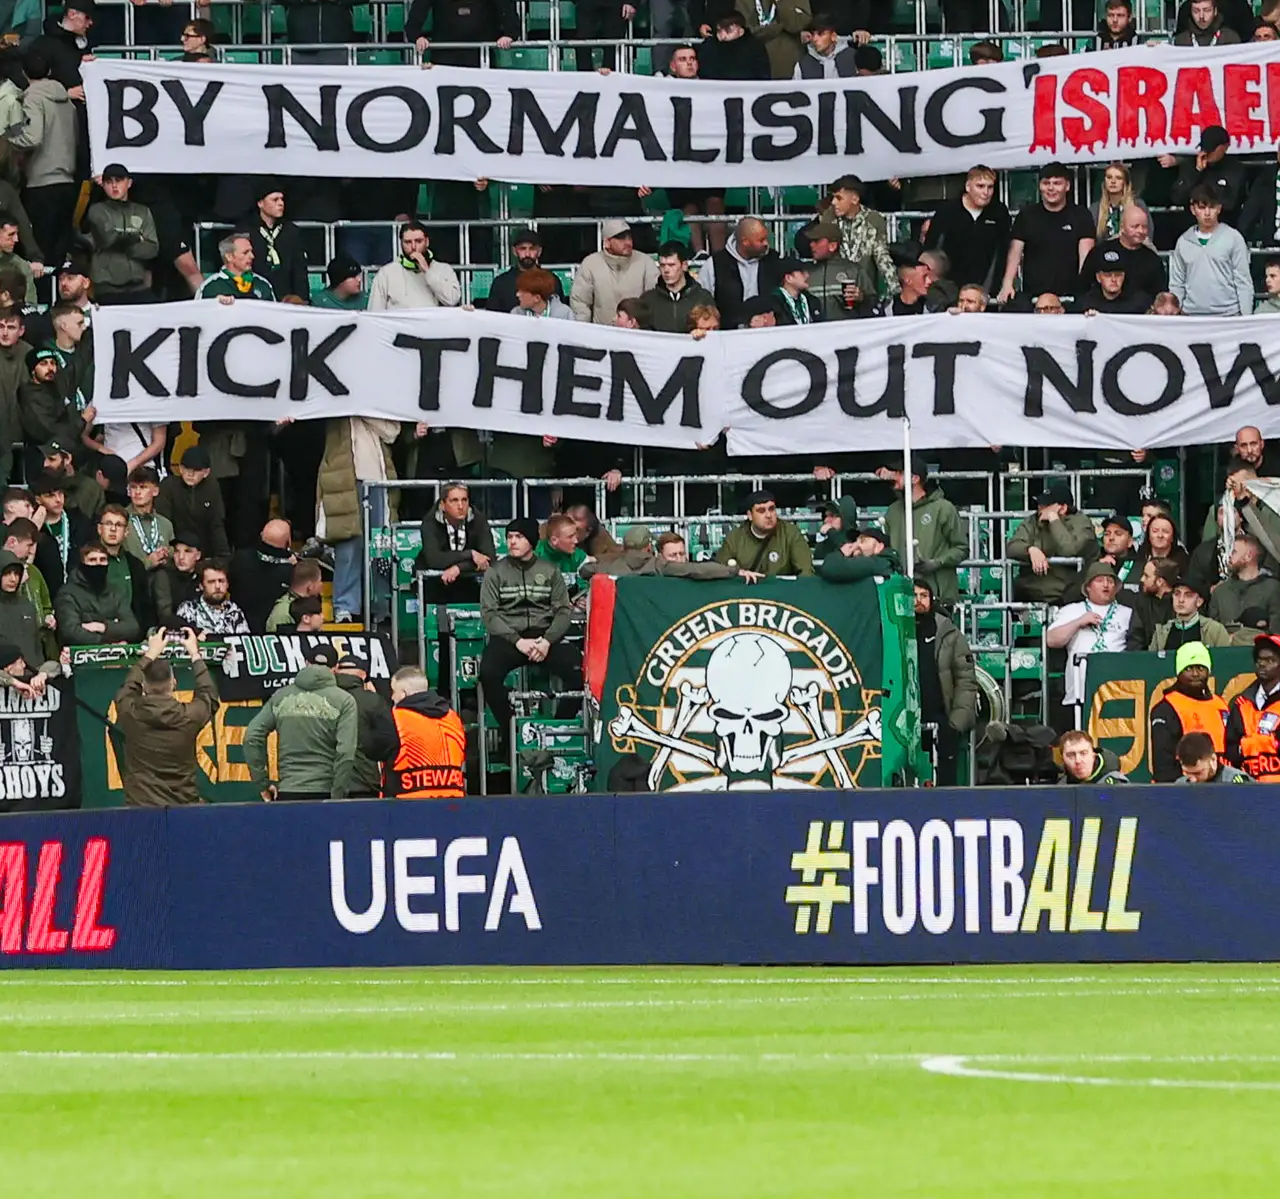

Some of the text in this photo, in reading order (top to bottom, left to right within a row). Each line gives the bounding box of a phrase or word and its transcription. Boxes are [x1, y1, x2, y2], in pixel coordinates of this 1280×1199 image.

[103, 78, 225, 150] BY
[261, 77, 1007, 165] NORMALISING
[109, 325, 358, 402] KICK
[392, 332, 705, 429] THEM
[740, 340, 982, 421] OUT
[222, 635, 308, 679] FUCK
[646, 602, 858, 691] GREEN BRIGADE
[328, 835, 543, 935] UEFA
[783, 817, 1142, 936] #FOOTBALL
